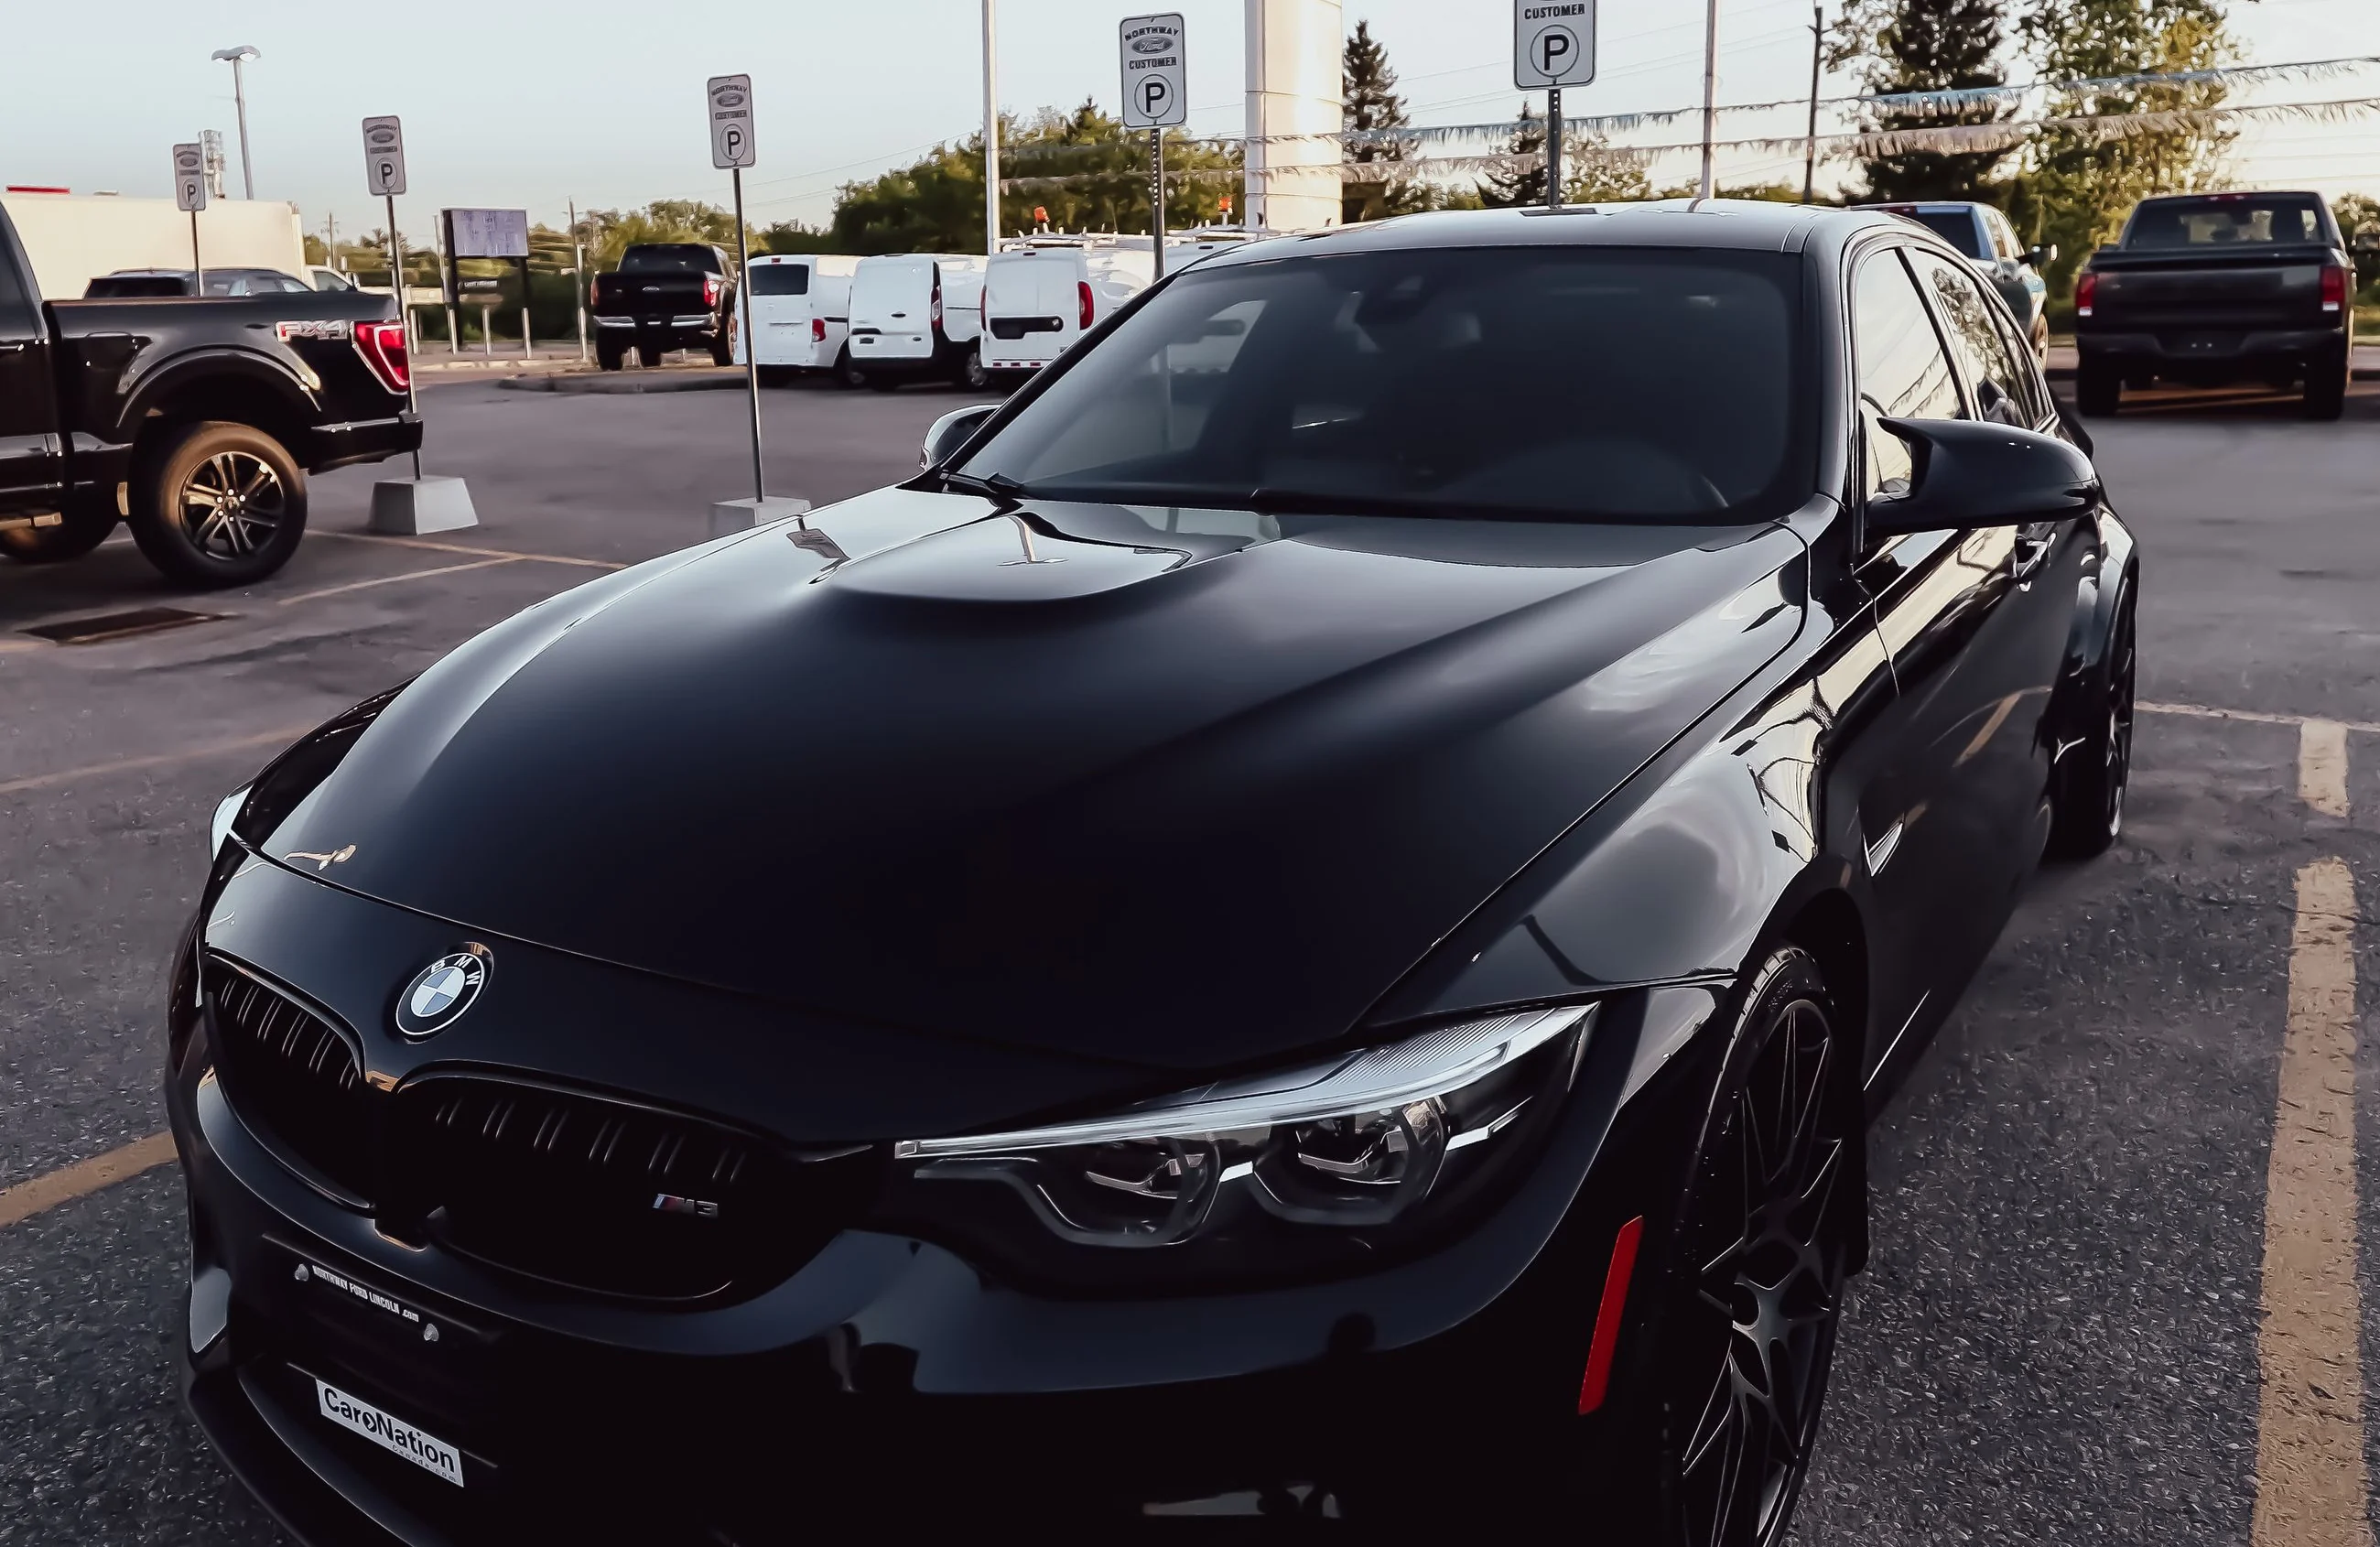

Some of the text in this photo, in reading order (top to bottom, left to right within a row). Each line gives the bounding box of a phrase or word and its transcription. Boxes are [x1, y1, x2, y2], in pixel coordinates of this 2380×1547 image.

[1524, 3, 1585, 20] CUSTOMER
[1124, 26, 1179, 41] NORTHWAY
[1128, 56, 1177, 70] CUSTOMER
[1543, 33, 1570, 71] P
[1144, 81, 1166, 114] P
[727, 130, 741, 156] P
[380, 163, 393, 184] P
[187, 184, 196, 203] P
[275, 319, 348, 342] FX4
[430, 955, 481, 986] BMW
[349, 1282, 368, 1300] FORD
[369, 1291, 400, 1314] LINCOLN
